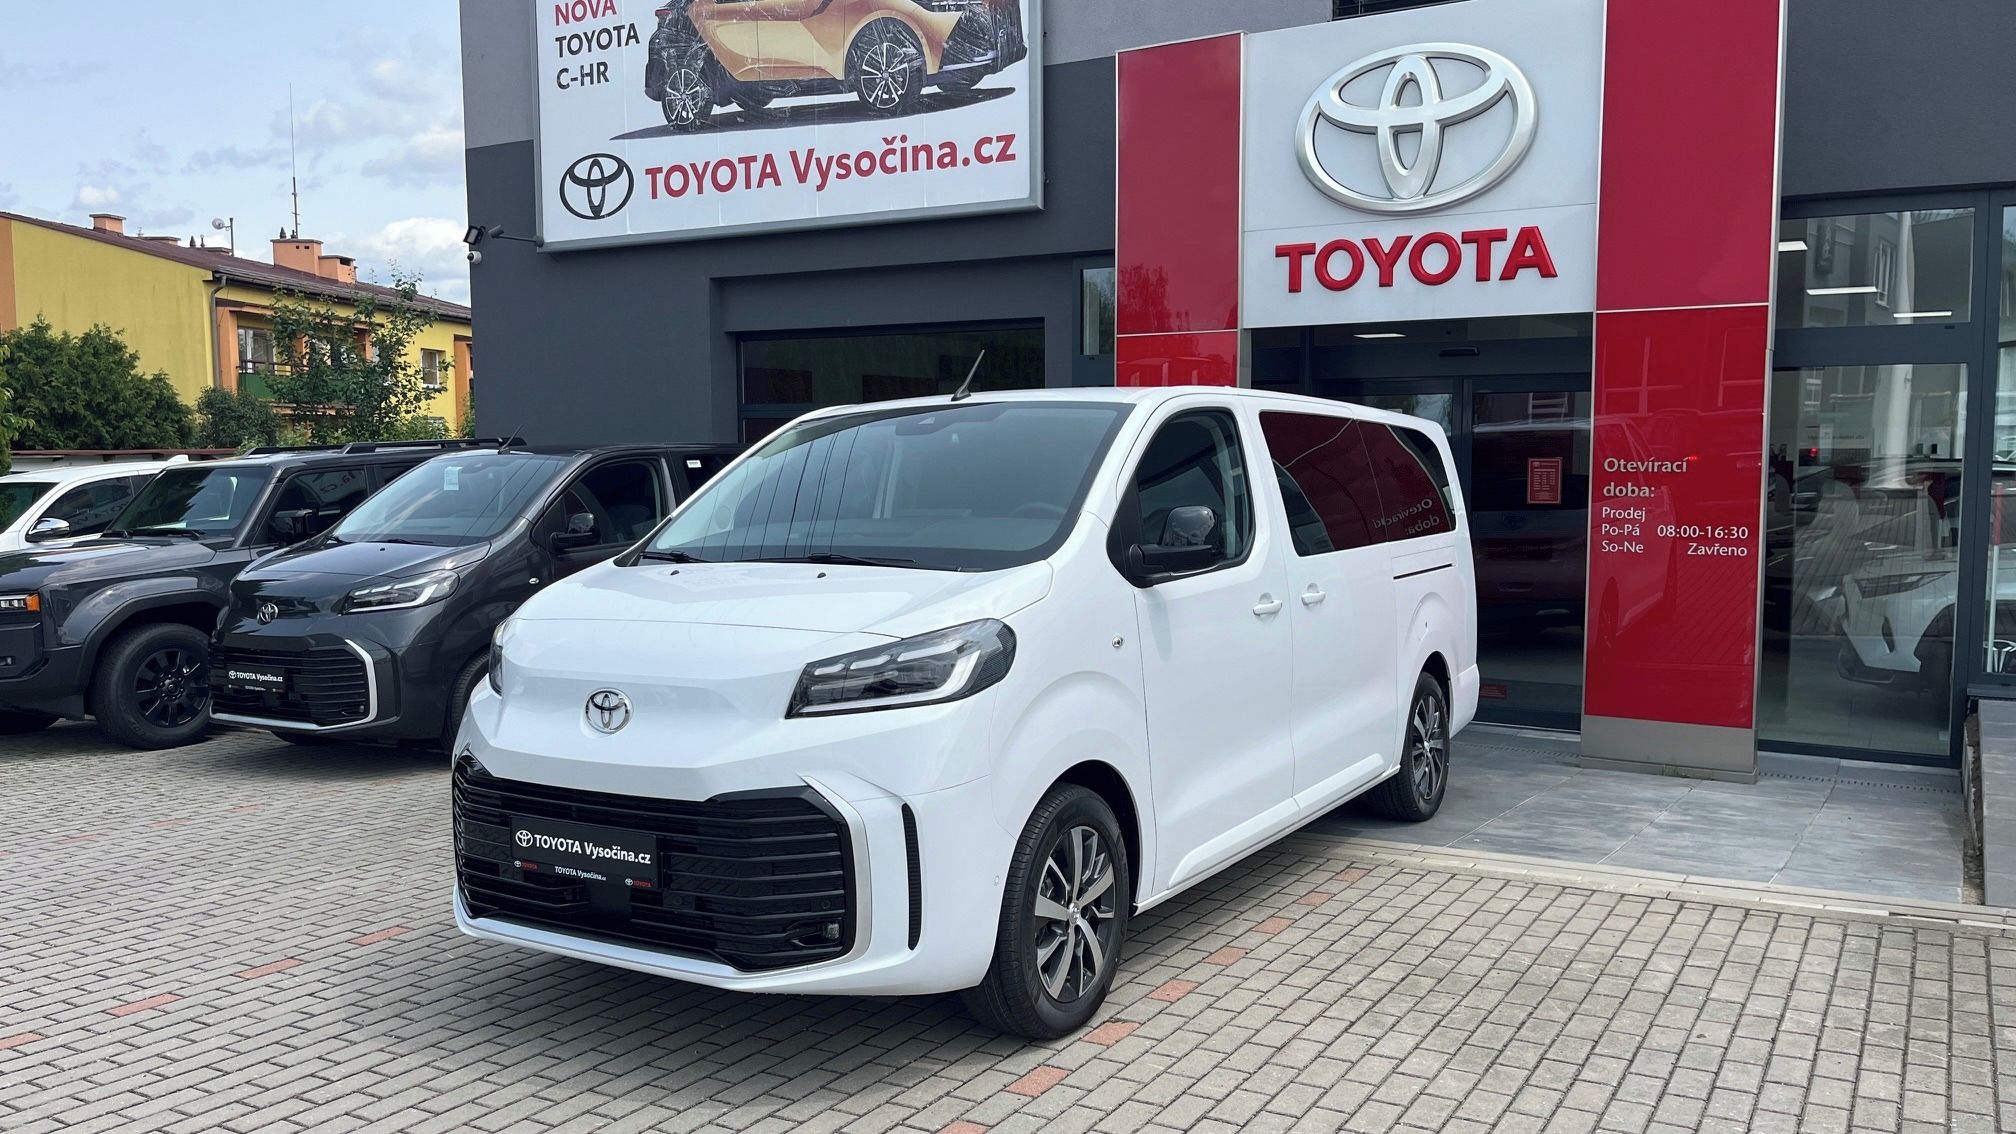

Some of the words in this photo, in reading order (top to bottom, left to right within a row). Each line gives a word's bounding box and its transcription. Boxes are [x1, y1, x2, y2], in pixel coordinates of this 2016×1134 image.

[555, 23, 640, 58] TOYOTA
[556, 62, 610, 90] C-HR
[645, 154, 782, 200] TOYOTA
[789, 133, 1017, 192] Vysočina.cz
[1275, 226, 1558, 293] TOYOTA
[1603, 457, 1688, 473] Otevírací
[1602, 482, 1655, 497] doba:
[1602, 506, 1646, 522] Prodej
[1601, 524, 1640, 536] Po-Pá
[1657, 525, 1749, 539] 08:00-16:30
[1601, 540, 1644, 553] So-Ne
[1687, 543, 1748, 557] Zavřeno
[534, 834, 582, 854] TOYOTA
[584, 841, 652, 865] Vysočina.cz
[554, 865, 577, 876] TOYOTA
